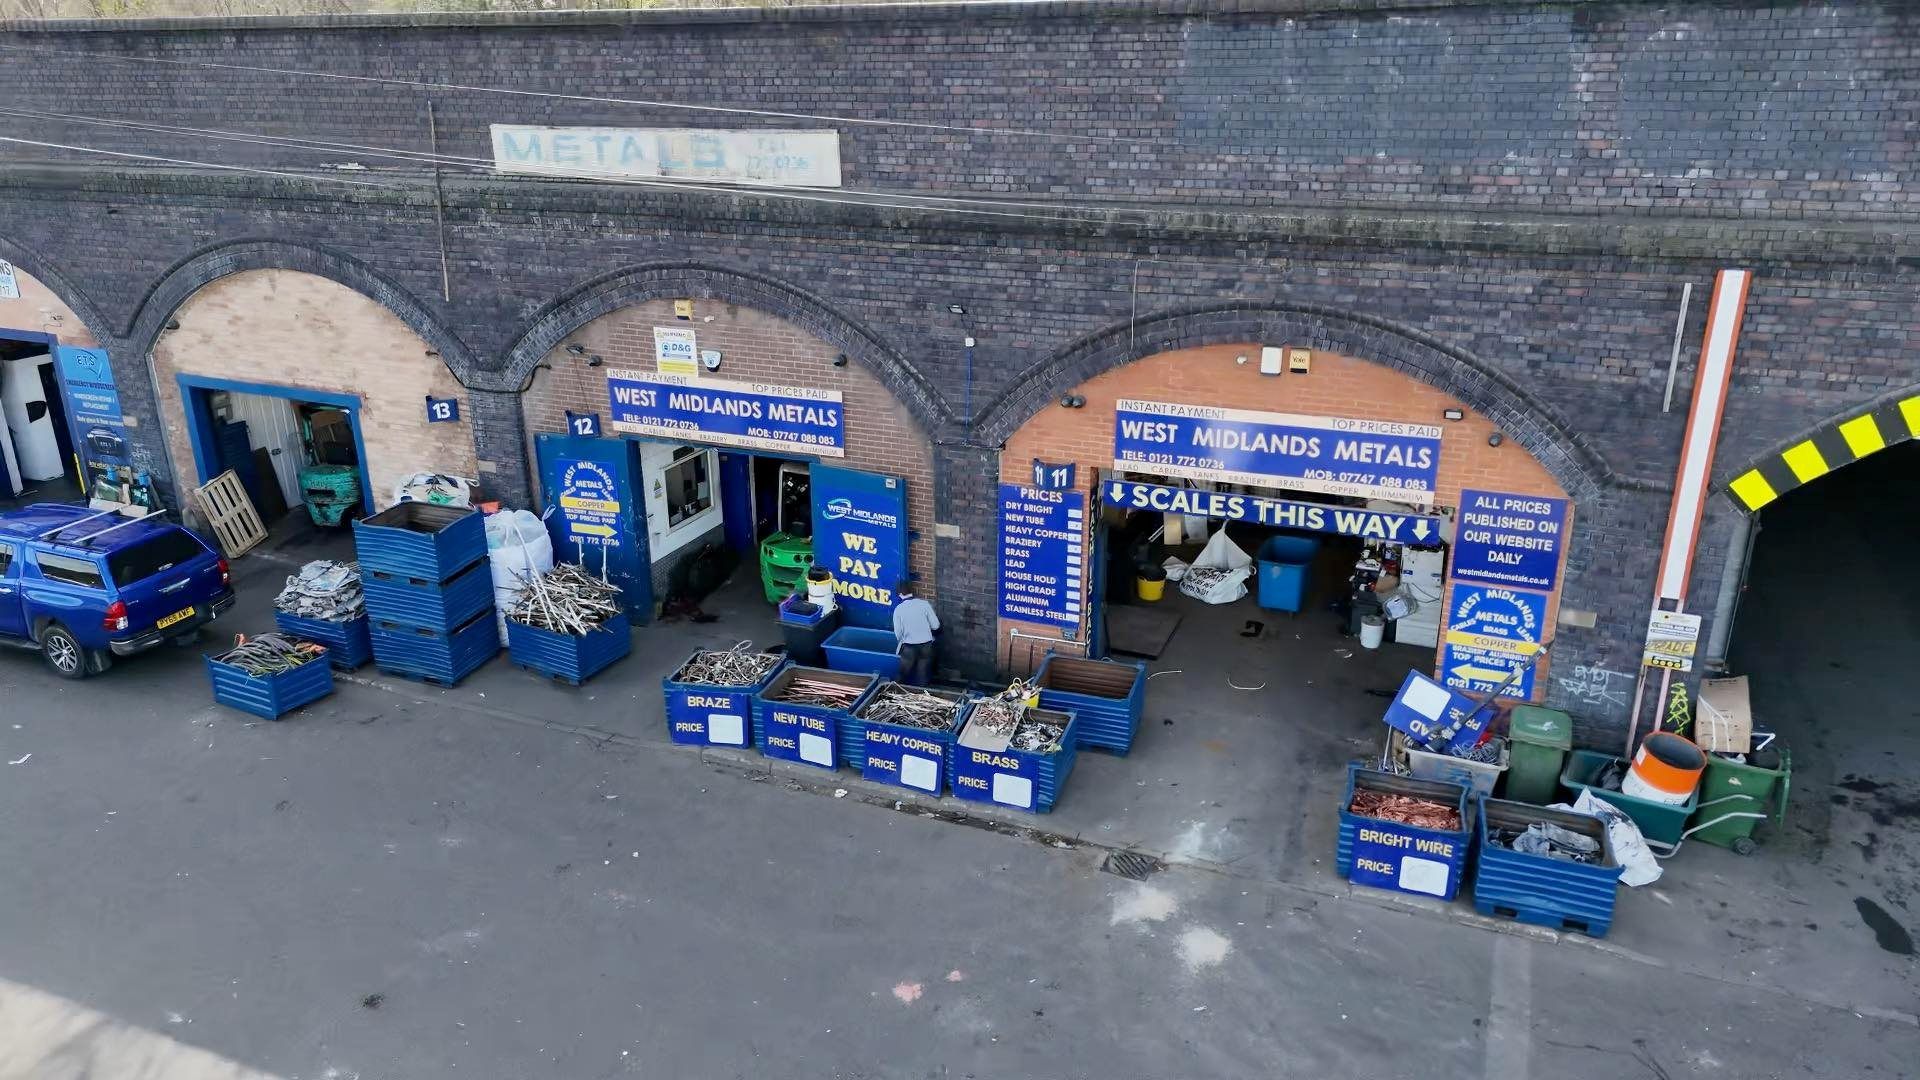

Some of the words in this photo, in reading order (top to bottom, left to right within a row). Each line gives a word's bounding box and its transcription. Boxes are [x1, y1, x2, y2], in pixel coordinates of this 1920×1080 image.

[671, 343, 692, 353] D&G
[610, 368, 643, 381] INSTANT
[646, 373, 687, 386] PAYMENT
[752, 384, 768, 393] TOP
[772, 386, 803, 397] PRICES
[806, 389, 828, 399] PAID
[432, 402, 451, 419] 13
[614, 386, 657, 408] WEST
[669, 392, 762, 419] MIDLANDS
[768, 402, 838, 428] METALS
[1121, 400, 1167, 415] INSTANT
[1170, 405, 1226, 420] PAYMENT
[574, 417, 594, 435] 12
[622, 413, 642, 424] TELE:
[642, 416, 661, 427] 0121
[661, 418, 678, 428] 772
[679, 421, 700, 431] 0736
[1331, 419, 1356, 431] TOP
[1360, 421, 1404, 435] PRICES
[1408, 426, 1440, 438] PAID
[747, 426, 772, 438] MOB:
[773, 430, 799, 442] 07747
[801, 434, 817, 444] 088
[818, 436, 835, 446] 083
[1121, 419, 1179, 444] WEST
[1191, 426, 1321, 459] MIDLANDS
[1333, 439, 1432, 469] METALS
[1121, 450, 1147, 462] TELE:
[1148, 452, 1173, 465] 0121
[1177, 455, 1196, 466] 772
[1198, 457, 1225, 470] 0736
[564, 465, 577, 487] WEST
[577, 461, 615, 493] MIDLANDS
[575, 480, 603, 489] METALS
[1051, 468, 1068, 488] 11
[1303, 468, 1337, 482] MOB:
[1338, 471, 1376, 484] 07747
[1379, 476, 1402, 488] 088
[1404, 479, 1428, 491] 083
[1020, 487, 1063, 504] PRICES
[1323, 484, 1360, 496] COPPER
[577, 500, 606, 510] COPPER
[827, 503, 853, 515] WEST
[853, 508, 897, 524] MIDLANDS
[1005, 501, 1023, 510] DRY
[1023, 503, 1054, 515] BRIGHT
[1131, 485, 1246, 520] SCALES
[1252, 499, 1325, 530] THIS
[1334, 510, 1407, 540] WAY
[1475, 496, 1501, 510] ALL
[1503, 498, 1552, 515] PRICES
[867, 519, 897, 529] METALS
[1005, 512, 1025, 522] NEW
[1025, 515, 1045, 526] TUBE
[1463, 512, 1535, 532] PUBLISHED
[1537, 521, 1559, 534] ON
[586, 536, 600, 546] 772
[1005, 524, 1033, 536] HEAVY
[1034, 528, 1068, 541] COPPER
[1463, 530, 1492, 545] OUR
[1495, 533, 1554, 552] WEBSITE
[841, 532, 878, 555] WE
[1005, 535, 1042, 548] BRAZIERY
[1005, 547, 1030, 558] BRASS
[1487, 550, 1524, 565] DAILY
[838, 556, 882, 579] PAY
[1005, 559, 1026, 569] LEAD
[1005, 570, 1032, 581] HOUSE
[1033, 574, 1057, 585] HOLD
[1457, 567, 1550, 586] westmidlandsmetals.co.uk
[832, 578, 893, 606] MORE
[1005, 581, 1026, 592] HIGH
[1027, 585, 1057, 597] GRADE
[1004, 604, 1044, 617] STAINLESS
[1045, 610, 1067, 621] STEEL
[1457, 591, 1481, 619] WEST
[1485, 589, 1536, 630] MIDLANDS
[1474, 610, 1519, 626] METALS
[1482, 624, 1509, 636] BRASS
[1516, 625, 1535, 643] LEAD
[1473, 636, 1517, 650] COPPER
[1452, 651, 1472, 661] TOP
[1473, 655, 1506, 667] PRICES
[1447, 677, 1470, 689] 0121
[1473, 681, 1494, 693] 772
[687, 695, 731, 709] BRAZE
[675, 722, 705, 733] PRICE:
[773, 711, 798, 725] NEW
[799, 715, 826, 732] TUBE
[768, 735, 796, 750] PRICE:
[866, 730, 900, 747] HEAVY
[902, 737, 943, 757] COPPER
[868, 756, 897, 772] PRICE:
[971, 750, 1020, 770] BRASS
[958, 775, 989, 790] PRICE:
[1359, 828, 1412, 849] BRIGHT
[1415, 837, 1454, 858] WIRE
[1356, 857, 1394, 876] PRICE:
